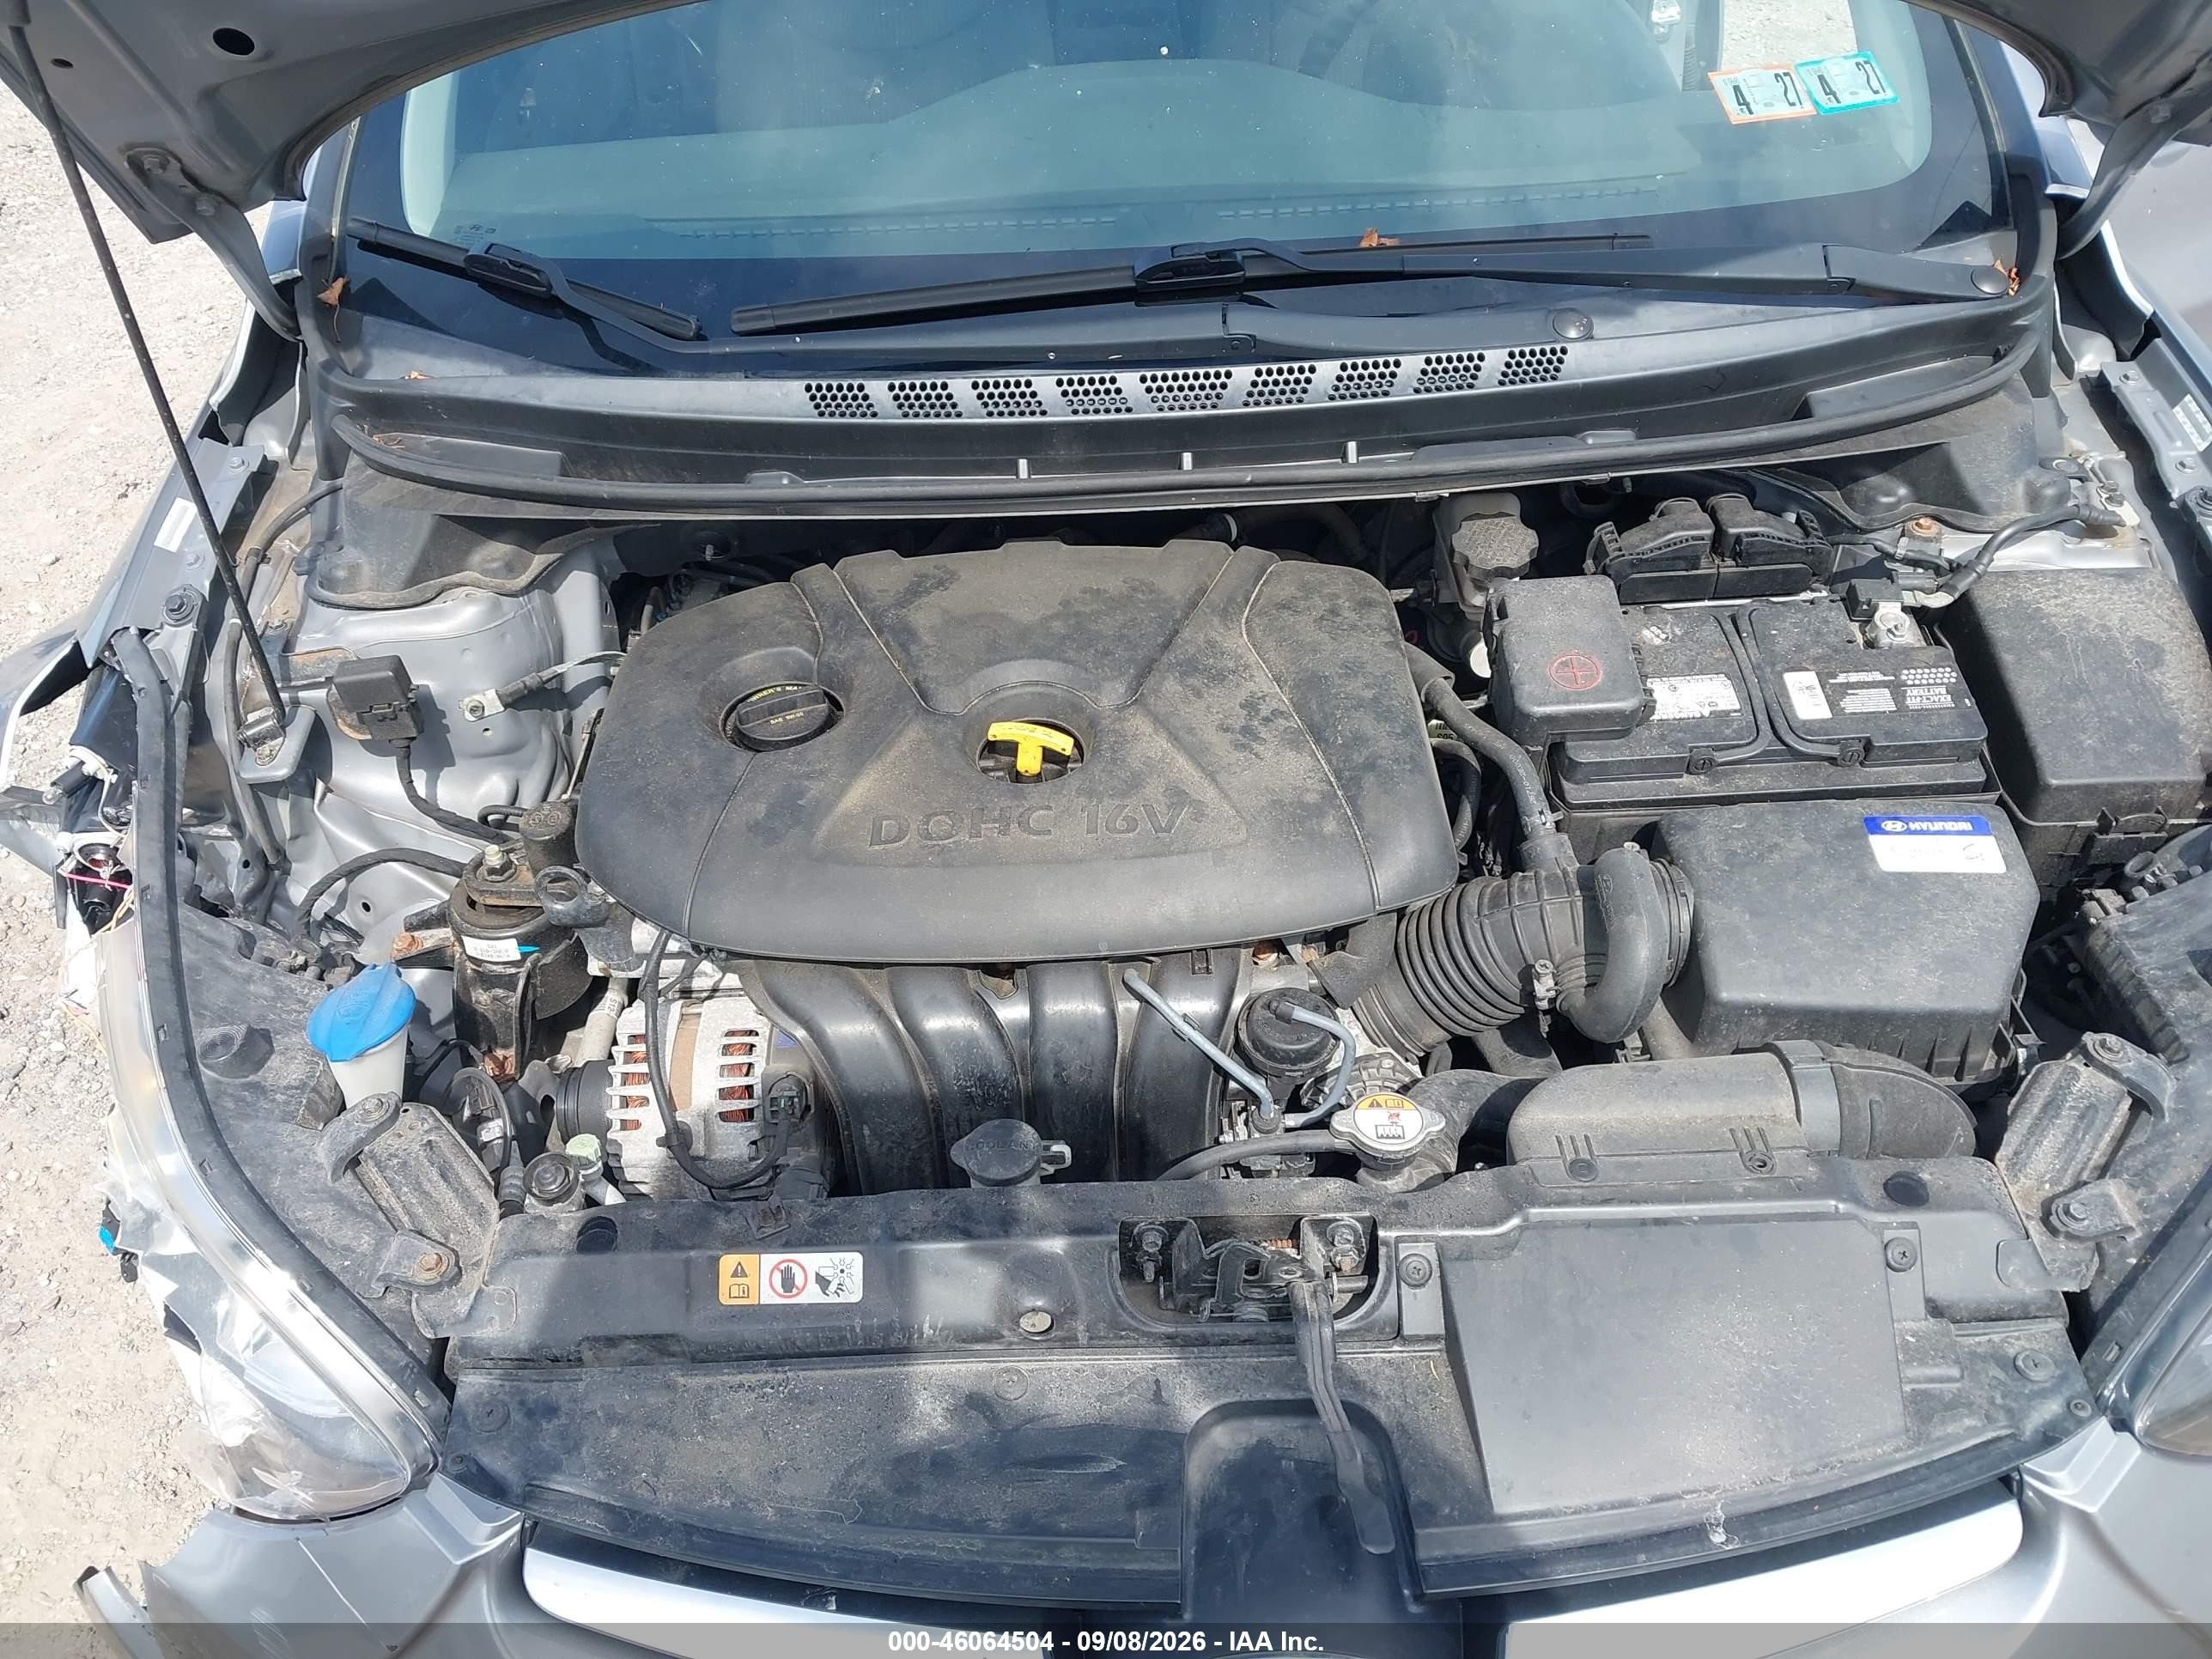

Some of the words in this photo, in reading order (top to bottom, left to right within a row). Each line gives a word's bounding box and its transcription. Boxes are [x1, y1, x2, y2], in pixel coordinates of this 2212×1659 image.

[1817, 74, 1841, 104] 4
[1855, 60, 1887, 95] 27
[1732, 85, 1754, 115] 4
[1774, 71, 1803, 106] 27
[746, 686, 781, 703] WNER'S
[1905, 687, 1948, 696] BATTERY
[1905, 694, 1953, 704] EXACT-FIT
[867, 805, 1055, 848] DOHC
[1080, 803, 1188, 837] 16V
[1908, 821, 1973, 831] HYUNDAI
